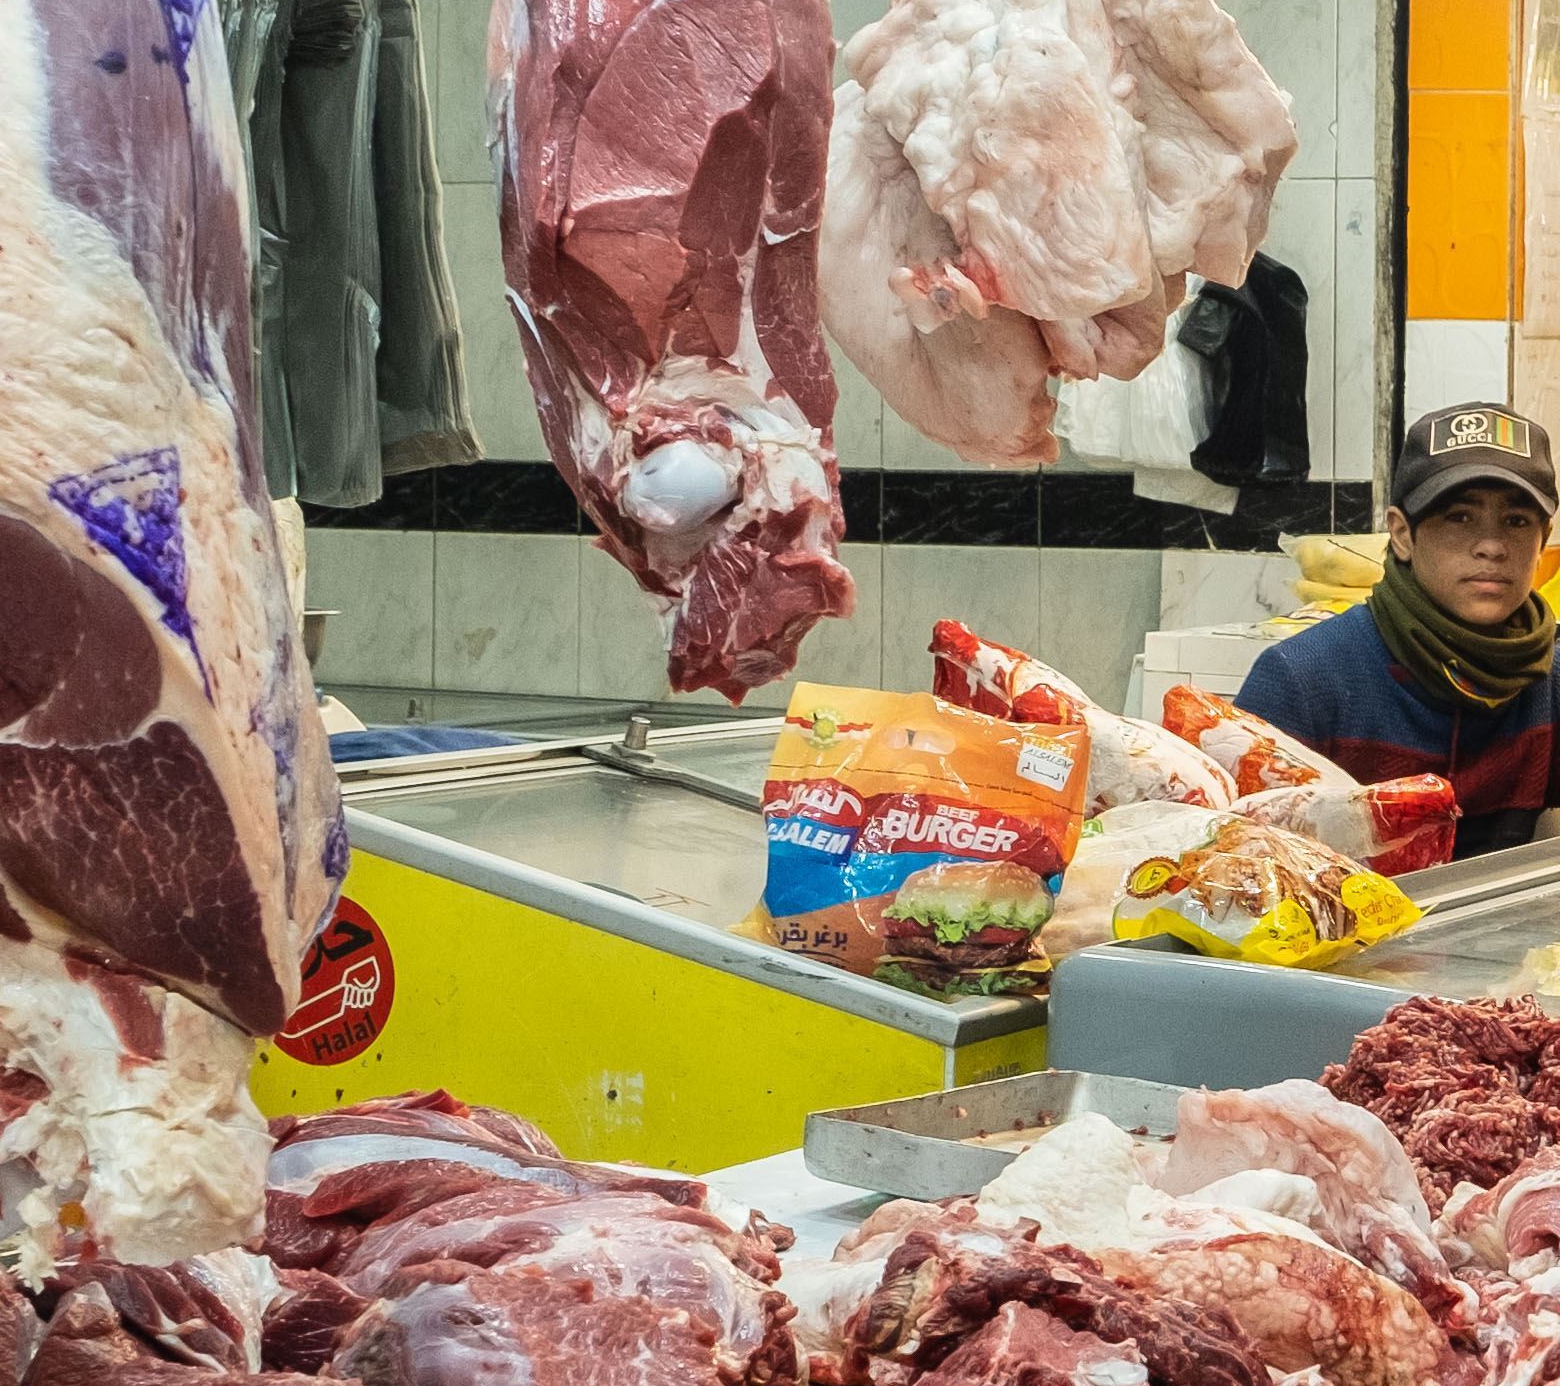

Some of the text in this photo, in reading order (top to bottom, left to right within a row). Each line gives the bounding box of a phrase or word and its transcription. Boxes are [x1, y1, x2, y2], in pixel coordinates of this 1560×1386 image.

[1446, 433, 1493, 447] GUCCI
[936, 804, 980, 820] BEEF
[884, 809, 1019, 853] BURGER
[813, 924, 848, 950] برغر
[311, 1012, 378, 1061] Halal
